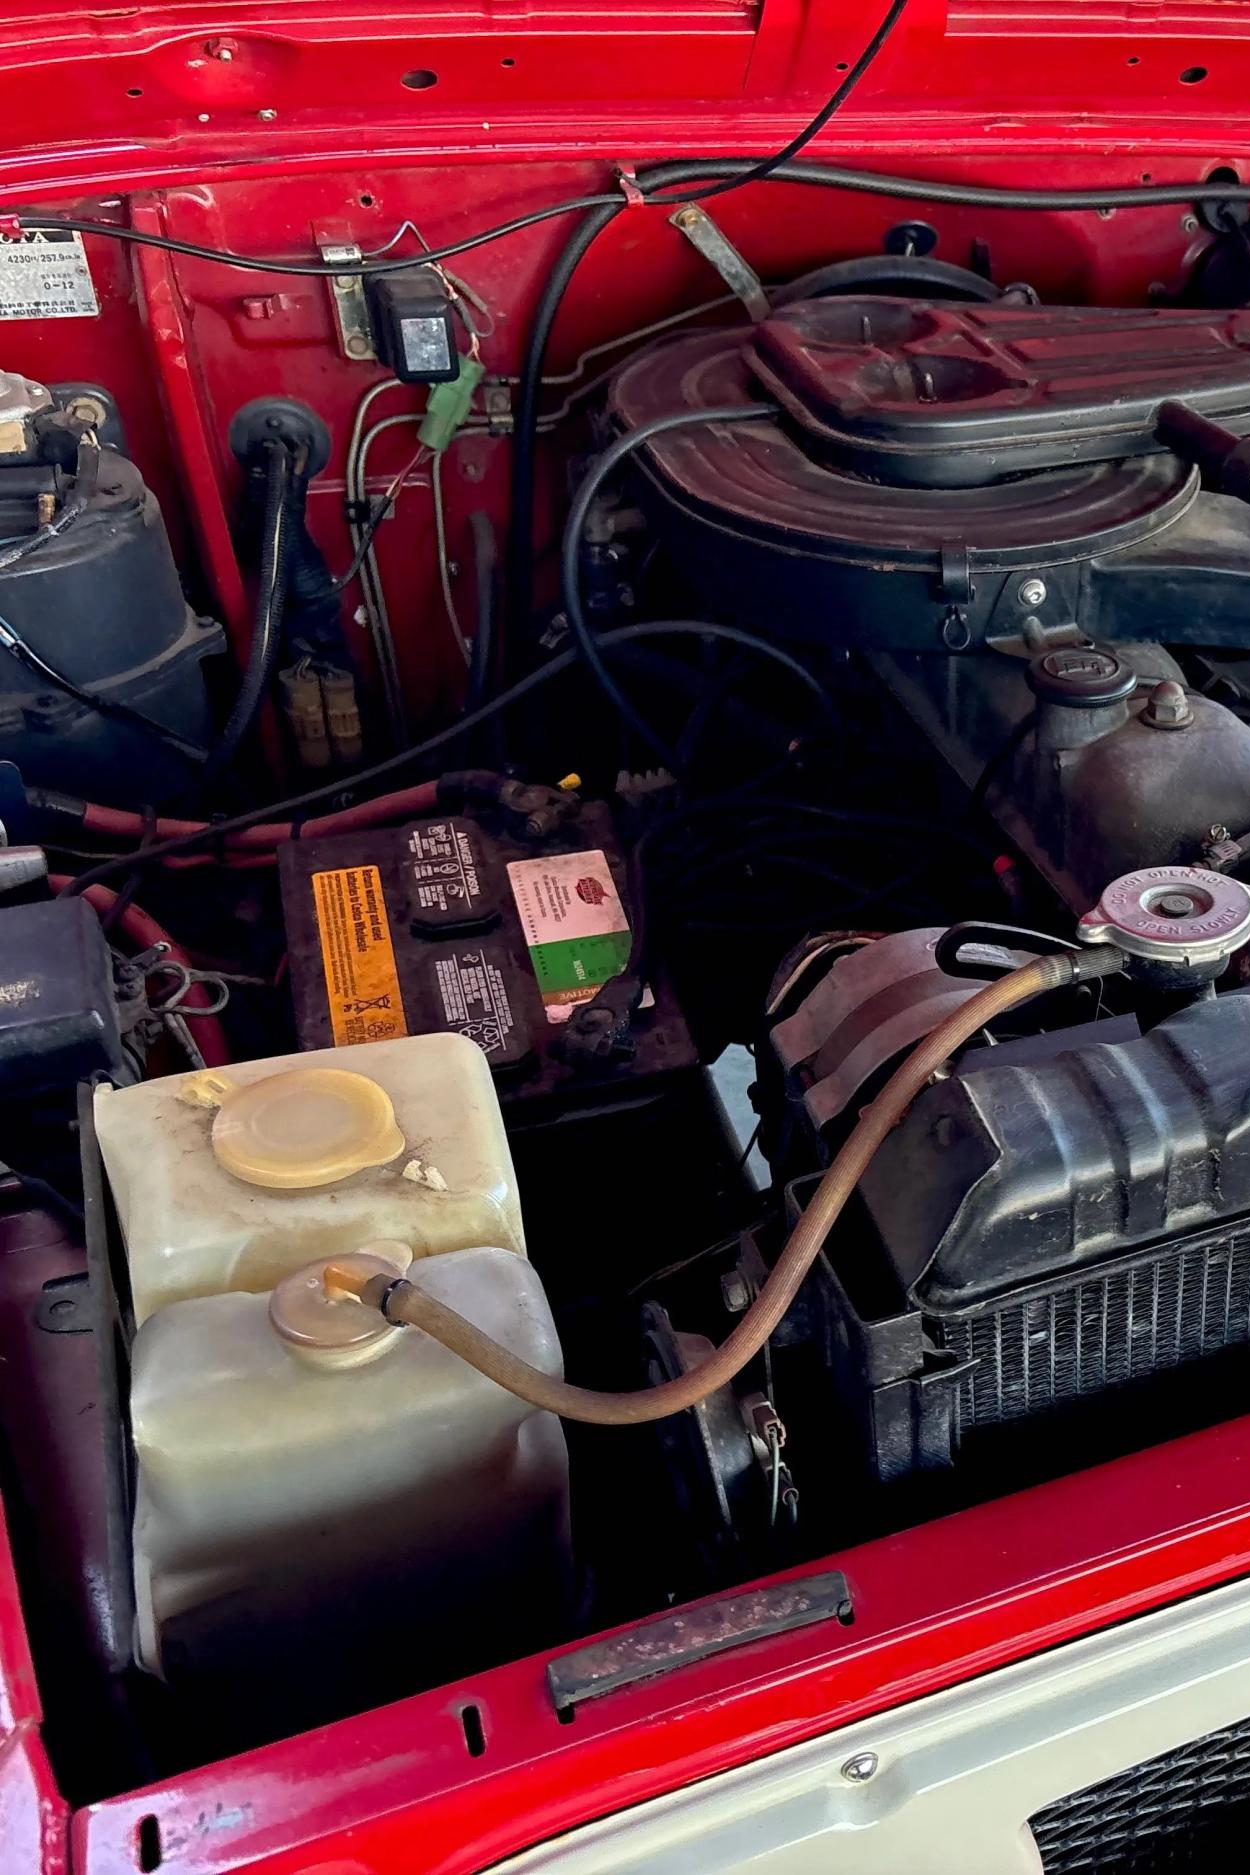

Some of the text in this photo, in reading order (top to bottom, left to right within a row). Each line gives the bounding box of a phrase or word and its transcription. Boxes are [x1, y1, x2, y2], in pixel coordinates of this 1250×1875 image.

[458, 838, 473, 865] DANGER
[346, 872, 358, 896] batteries
[465, 870, 480, 896] POISON
[1148, 870, 1192, 881] OPEN
[351, 902, 364, 921] Costco
[362, 869, 383, 941] Return warranty and used
[1137, 907, 1240, 935] OPEN SLOWLY
[354, 921, 368, 953] Wholesale
